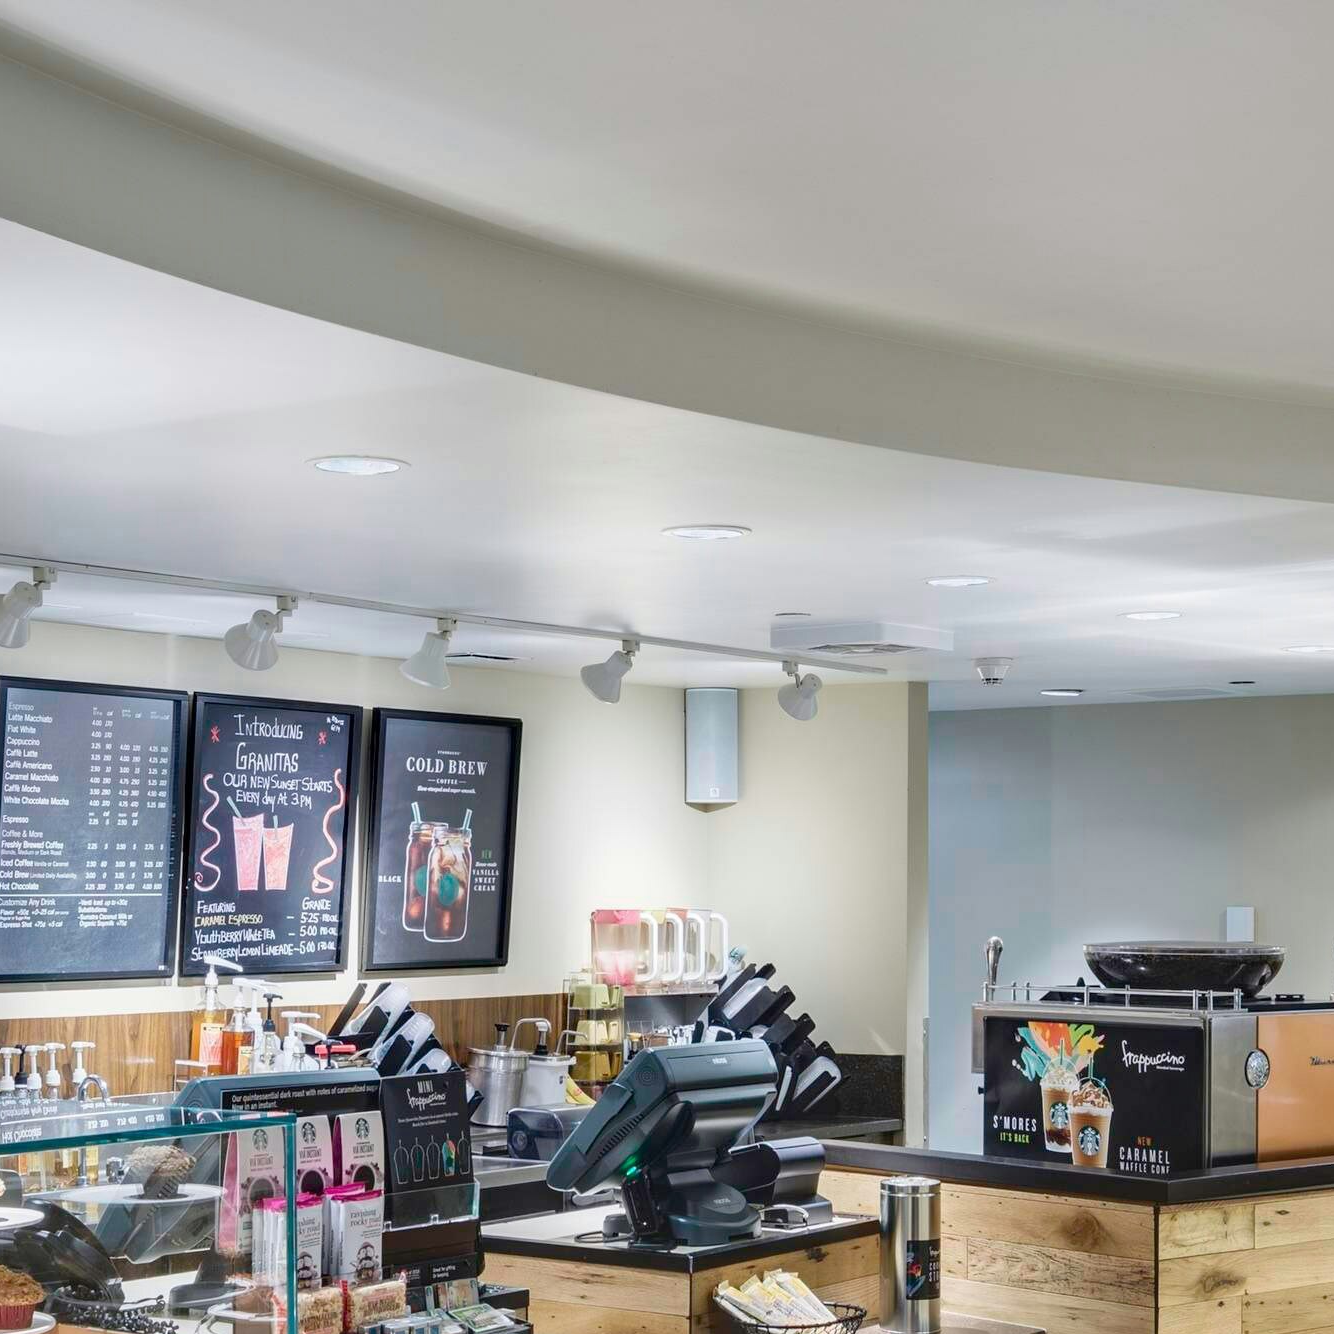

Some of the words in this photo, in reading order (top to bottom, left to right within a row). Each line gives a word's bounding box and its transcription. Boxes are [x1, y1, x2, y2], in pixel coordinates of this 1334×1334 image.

[406, 756, 444, 774] COLD
[449, 759, 488, 776] BREW
[473, 868, 499, 876] VANILLA
[378, 875, 402, 883] BLACK
[474, 876, 496, 884] SWEET
[417, 1081, 433, 1094] MINI
[992, 1115, 1037, 1133] S'MORES
[1000, 1132, 1013, 1142] IT'S
[1014, 1133, 1030, 1143] BACK
[1137, 1137, 1152, 1146] NEW
[1119, 1146, 1170, 1165] CARAMEL
[1119, 1161, 1147, 1173] WAFFLE
